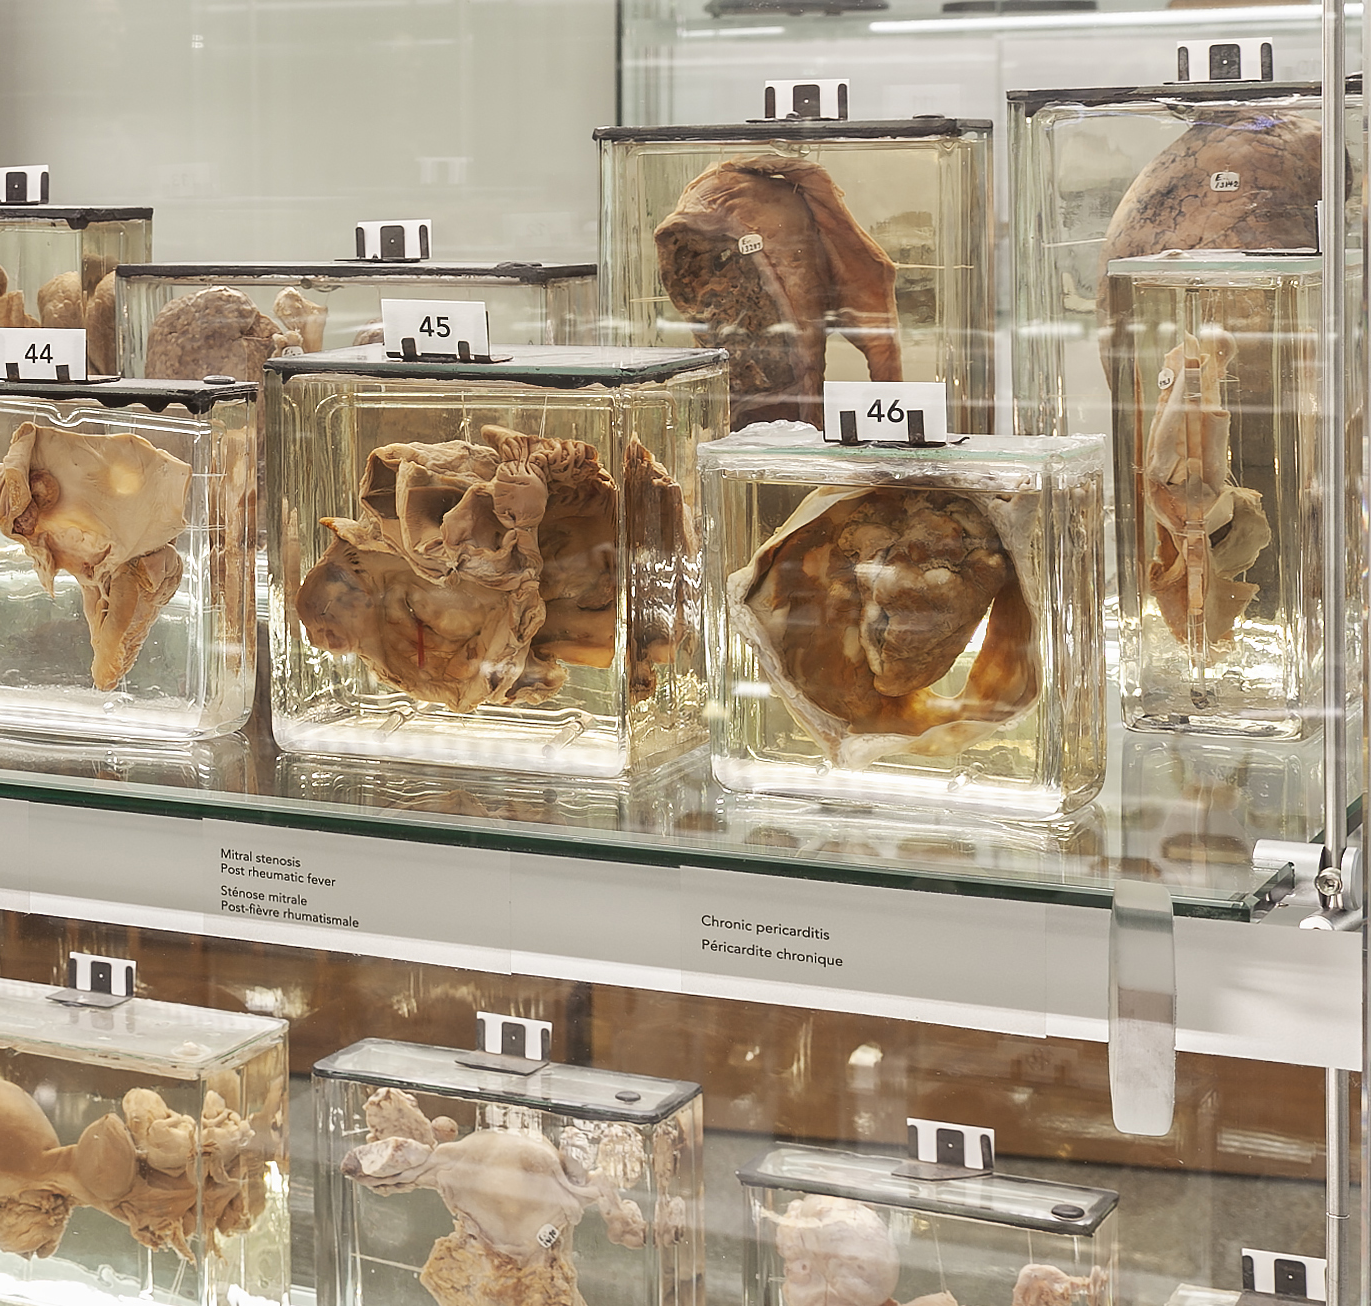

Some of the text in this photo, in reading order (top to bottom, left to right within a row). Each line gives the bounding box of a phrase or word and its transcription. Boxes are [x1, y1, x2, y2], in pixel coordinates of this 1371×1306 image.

[420, 316, 451, 338] 45
[24, 343, 53, 364] 44
[866, 399, 905, 424] 46
[221, 848, 301, 867] Mitral stenosis
[221, 863, 336, 886] Post rheumatic fever
[221, 885, 307, 906] Sténose mitrale
[221, 900, 359, 928] Post-fièvre rhumatismale
[701, 915, 830, 940] Chronic pericarditis
[702, 939, 843, 968] Péricardite chronique
